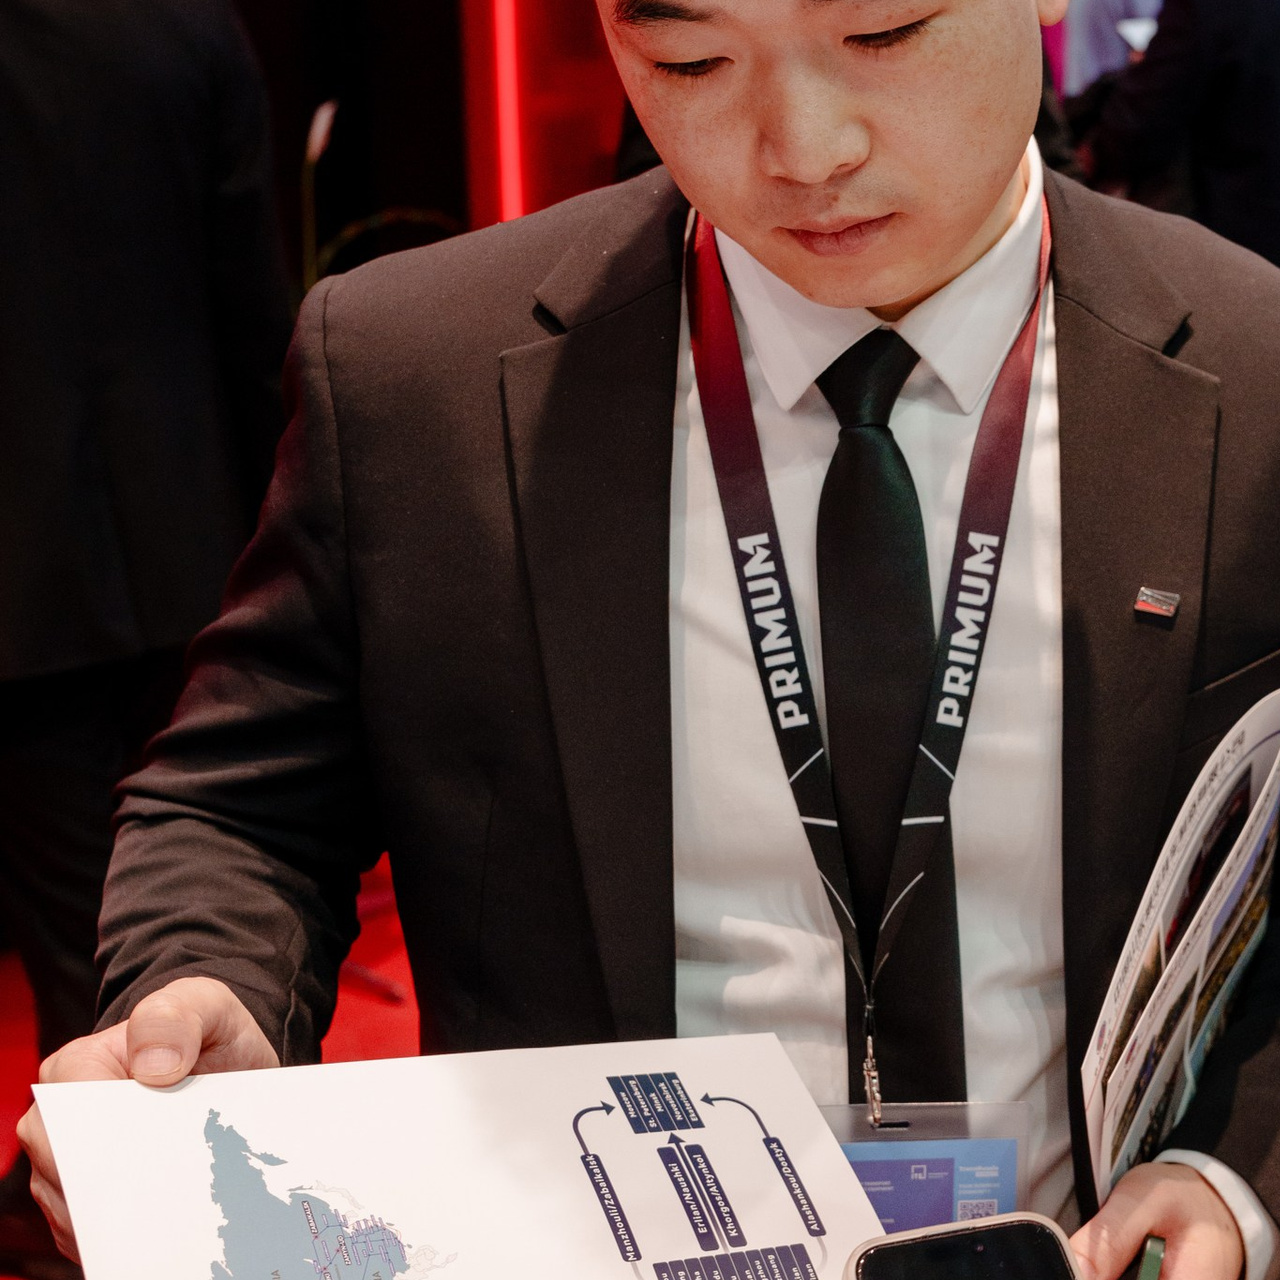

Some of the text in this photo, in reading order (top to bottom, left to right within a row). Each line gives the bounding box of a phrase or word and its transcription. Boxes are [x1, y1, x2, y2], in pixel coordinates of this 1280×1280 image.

[737, 532, 809, 730] PRIMUM
[936, 531, 1000, 729] PRIMUM
[620, 1091, 637, 1118] Moscow
[629, 1079, 651, 1117] Petersburg
[649, 1092, 664, 1112] Minsk
[658, 1082, 683, 1121] Novosibirsk
[671, 1079, 699, 1122] Ekaterinburg
[586, 1154, 637, 1261] Manzhouli/Zabaikalsk
[668, 1163, 708, 1234] Erlian/Naushki
[693, 1154, 739, 1237] Khorgos/Altynkol
[769, 1141, 820, 1232] Alashankou/Dostyk
[303, 1201, 317, 1233] ZABAIKALSK
